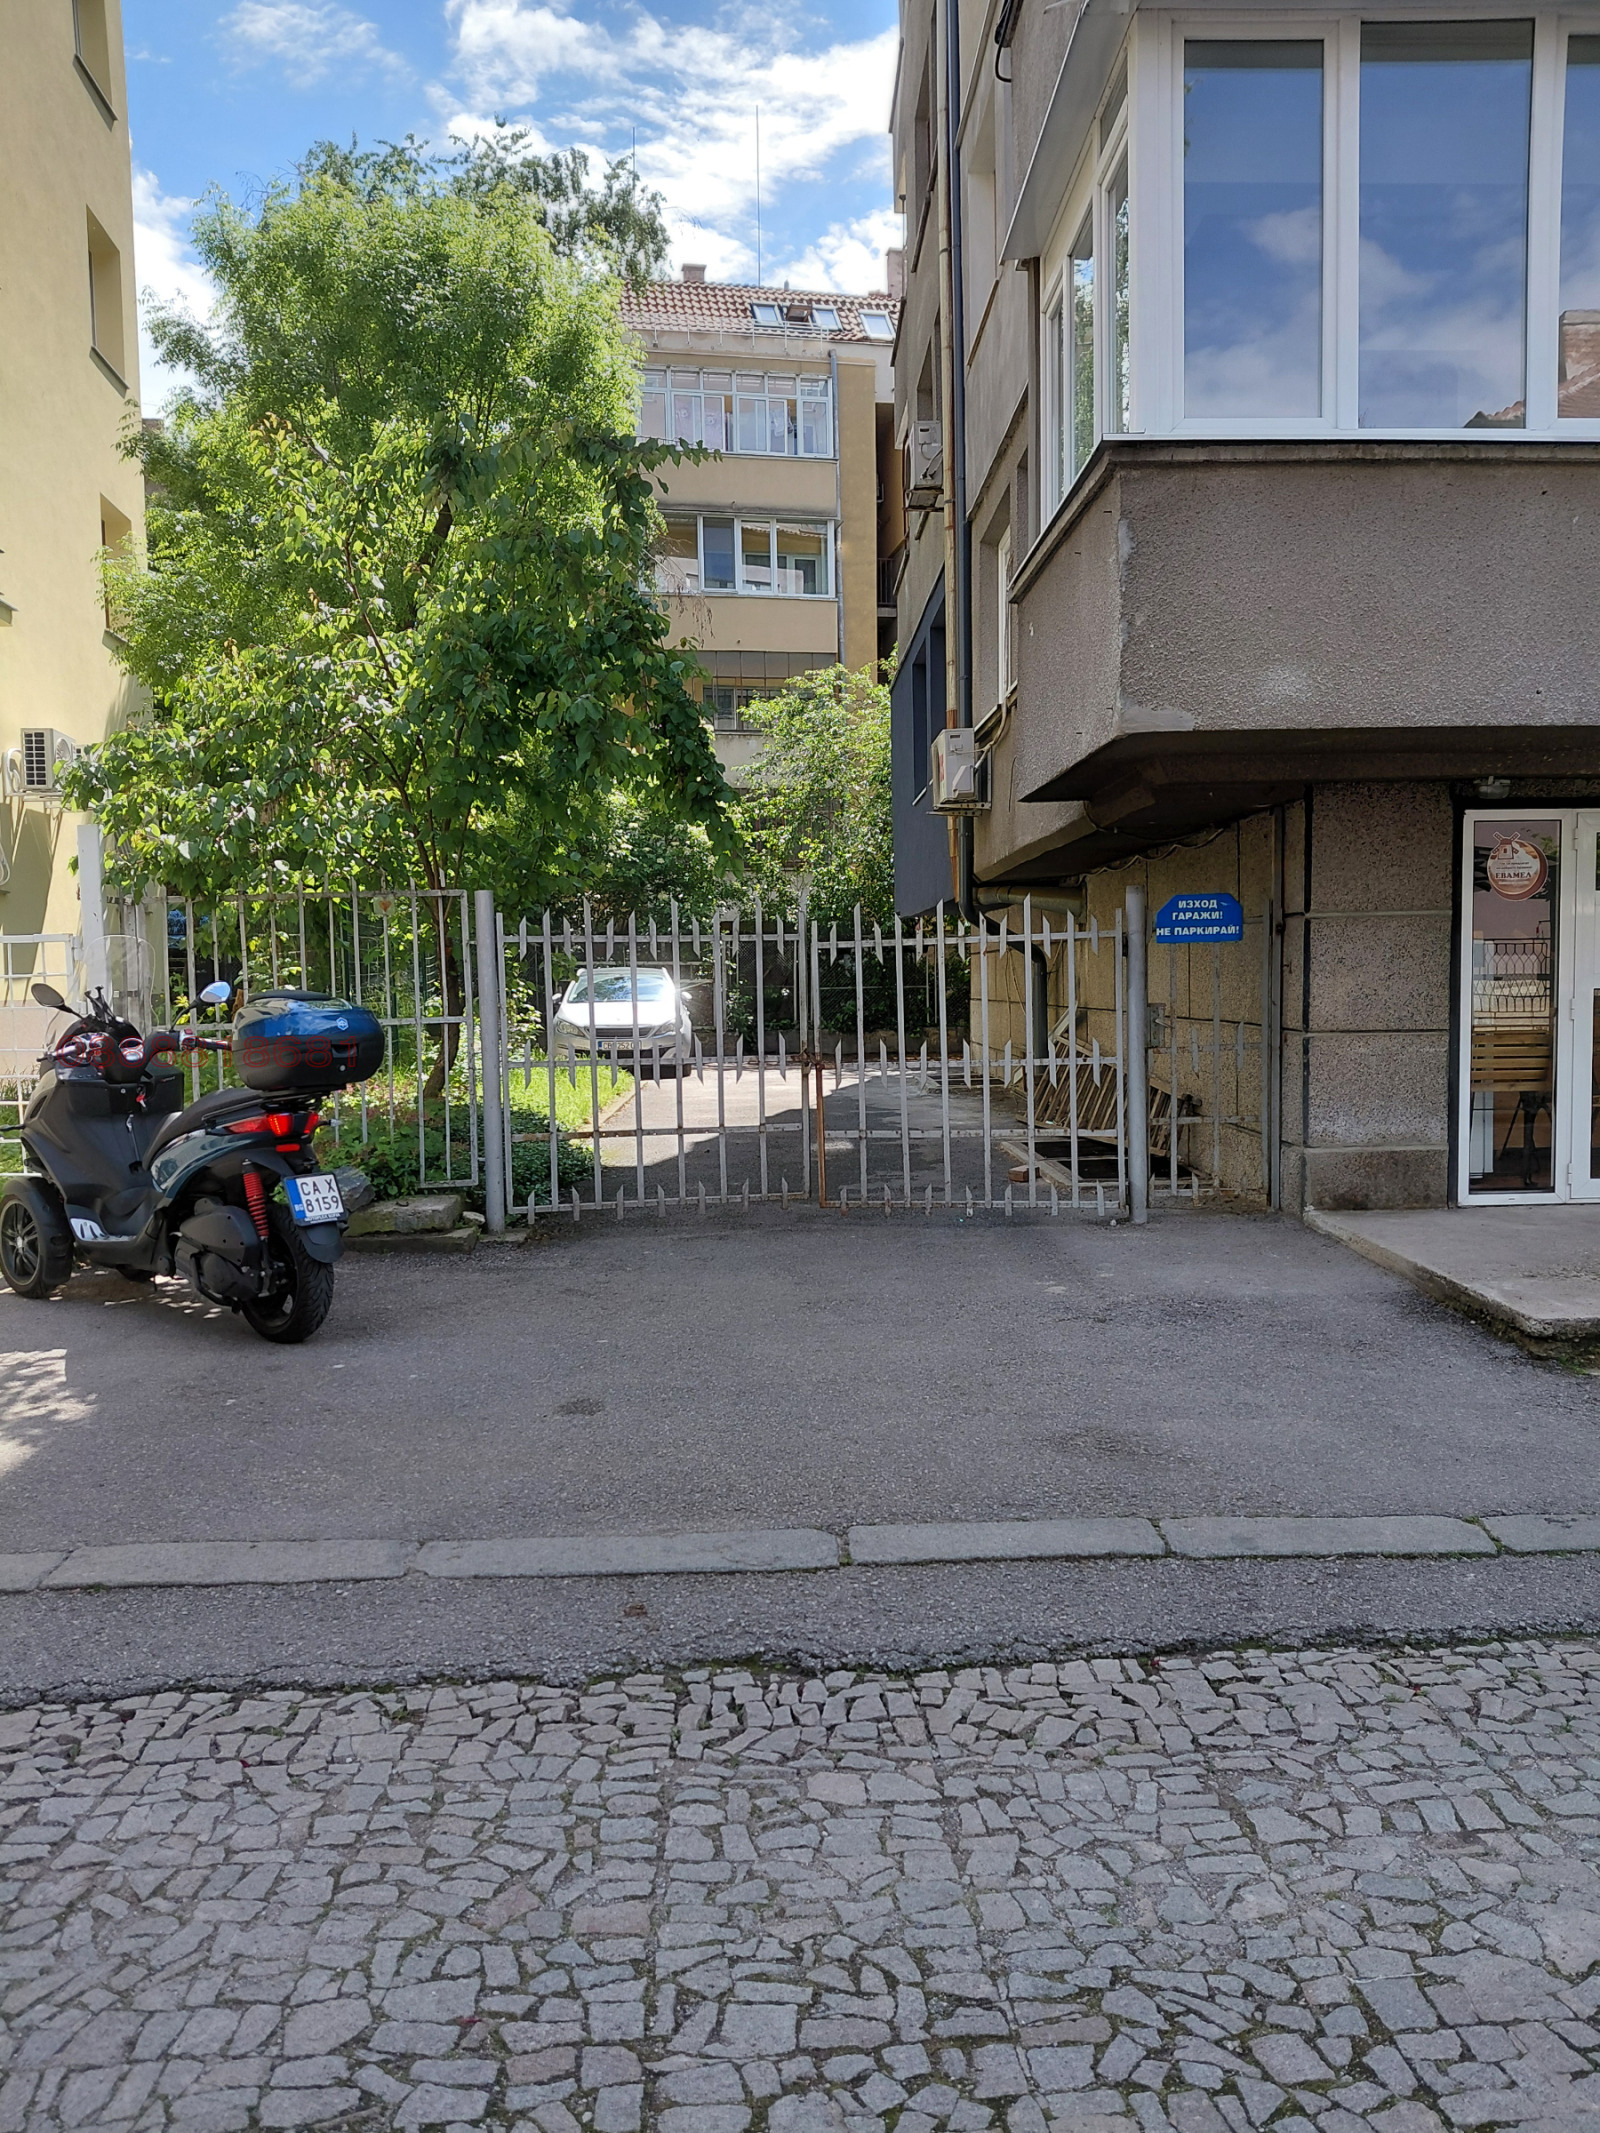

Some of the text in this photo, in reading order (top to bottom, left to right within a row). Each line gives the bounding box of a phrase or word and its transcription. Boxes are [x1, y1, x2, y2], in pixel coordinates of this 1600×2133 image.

[1178, 899, 1217, 909] ИЗХОД
[1172, 911, 1223, 920] ГАРАЖИ!
[1156, 924, 1240, 936] НЕ ПАРКИРАЙ!
[300, 1178, 336, 1196] CA X
[305, 1195, 339, 1213] 8159
